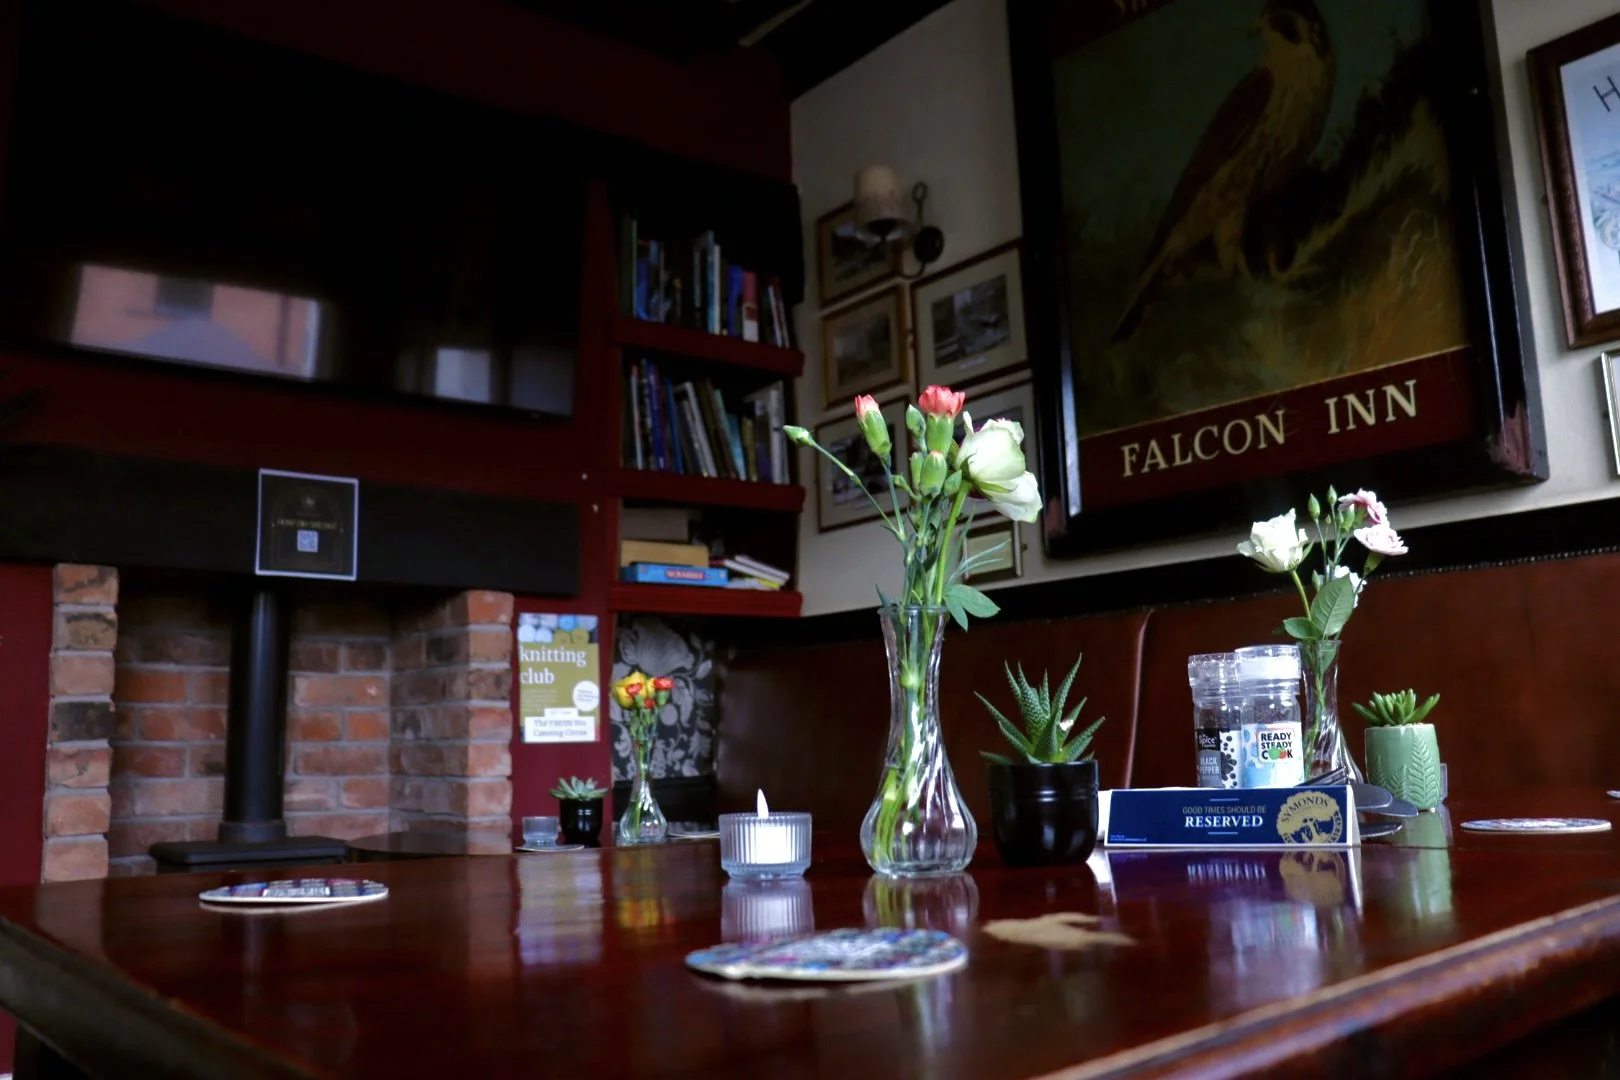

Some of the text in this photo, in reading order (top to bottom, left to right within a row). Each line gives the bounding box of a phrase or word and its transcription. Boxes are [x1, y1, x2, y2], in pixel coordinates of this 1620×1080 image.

[1120, 379, 1418, 477] FALCON INN
[519, 645, 587, 667] knitting
[519, 667, 555, 684] club
[1261, 732, 1292, 741] READY
[1261, 741, 1292, 749] STEADY
[1200, 757, 1217, 766] BLACK
[1200, 766, 1219, 775] PEPPER
[1182, 805, 1267, 814] GOOD TIMES SHOULD BE
[1282, 796, 1328, 822] SYMONDS
[1184, 815, 1264, 828] RESERVED
